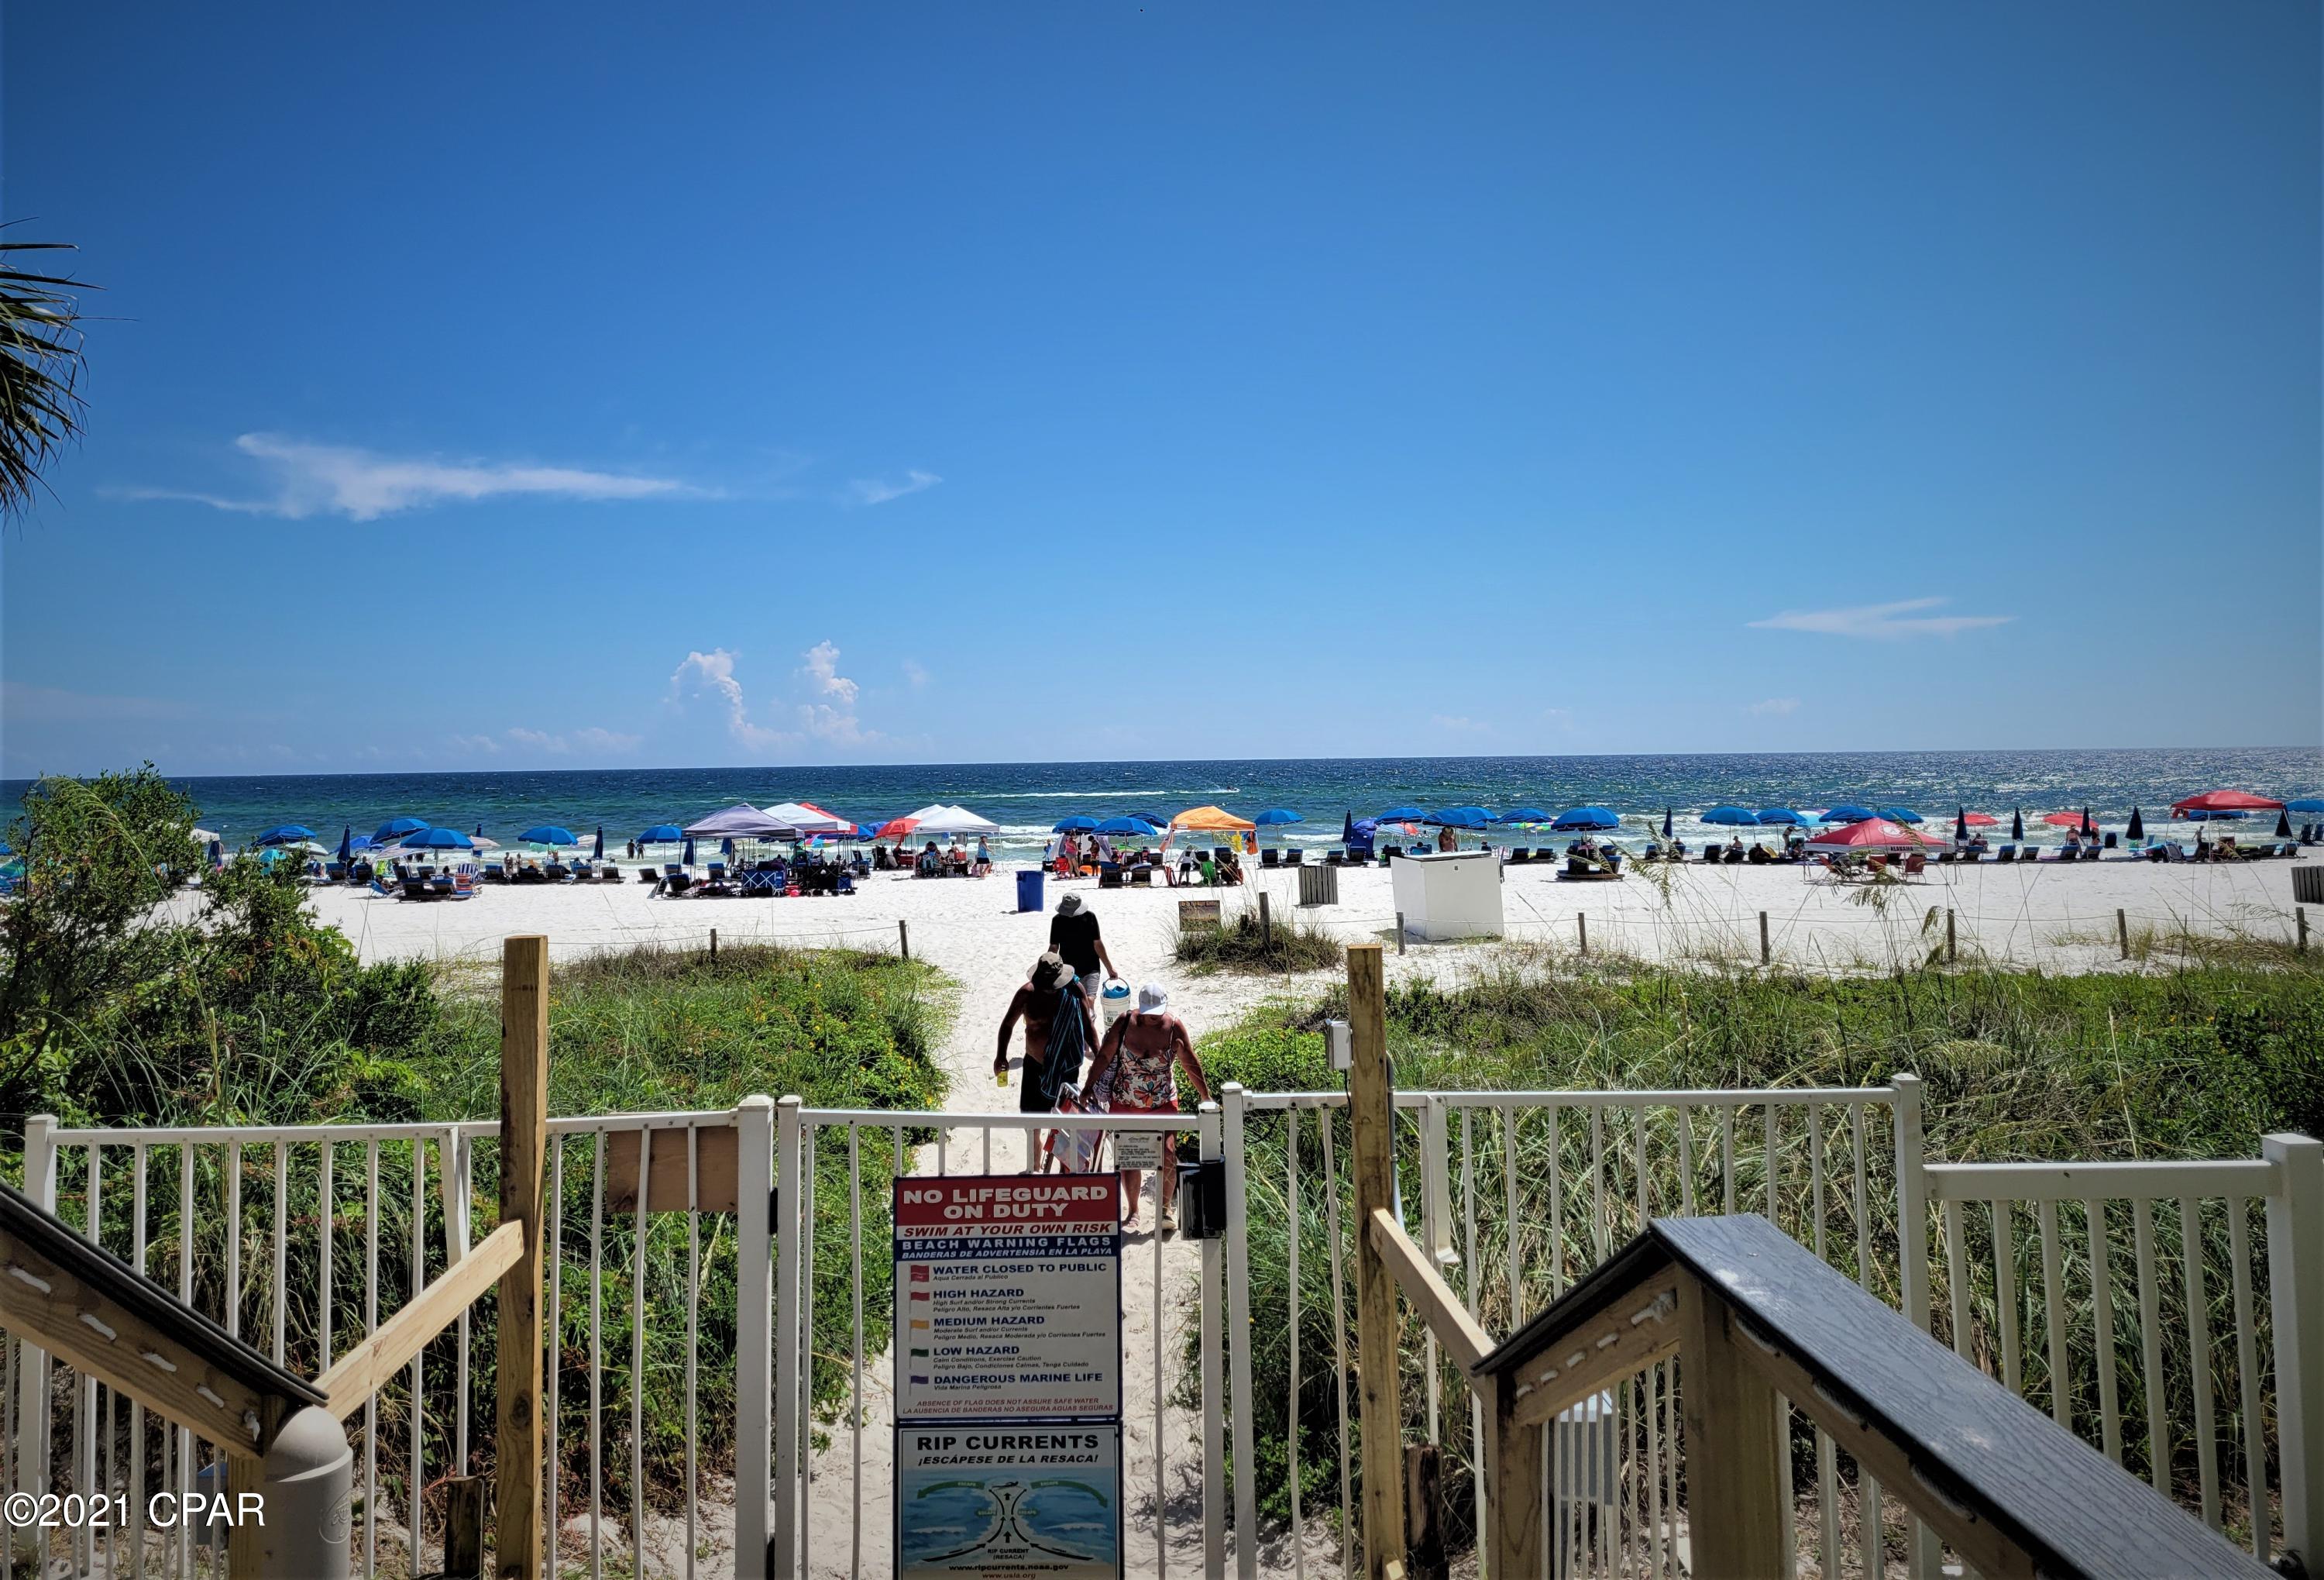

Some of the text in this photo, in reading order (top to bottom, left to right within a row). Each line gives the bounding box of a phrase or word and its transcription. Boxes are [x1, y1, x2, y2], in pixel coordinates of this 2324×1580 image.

[903, 1186, 1108, 1204] NO LIFEGUARD
[944, 1203, 1068, 1219] ON DUTY
[904, 1224, 1112, 1237] SWIM AT YOUR OWN RISK
[902, 1237, 1111, 1251] BEACH WARNING FLAGS
[902, 1251, 957, 1259] BANDERAS
[975, 1248, 1046, 1257] ADVERTENSIA
[933, 1263, 1107, 1275] WATER CLOSED TO PUBLIC
[933, 1289, 1024, 1299] HIGH HAZARD
[933, 1316, 1044, 1327] MEDIUM HAZARD
[933, 1346, 1020, 1356] LOW HAZARD
[934, 1372, 1103, 1385] DANGEROUS MARINE LIFE
[917, 1434, 1098, 1451] RIP CURRENTS
[918, 1454, 993, 1466] ¡ESCÁPESE
[997, 1455, 1016, 1464] DE
[1040, 1454, 1098, 1463] RESACA!
